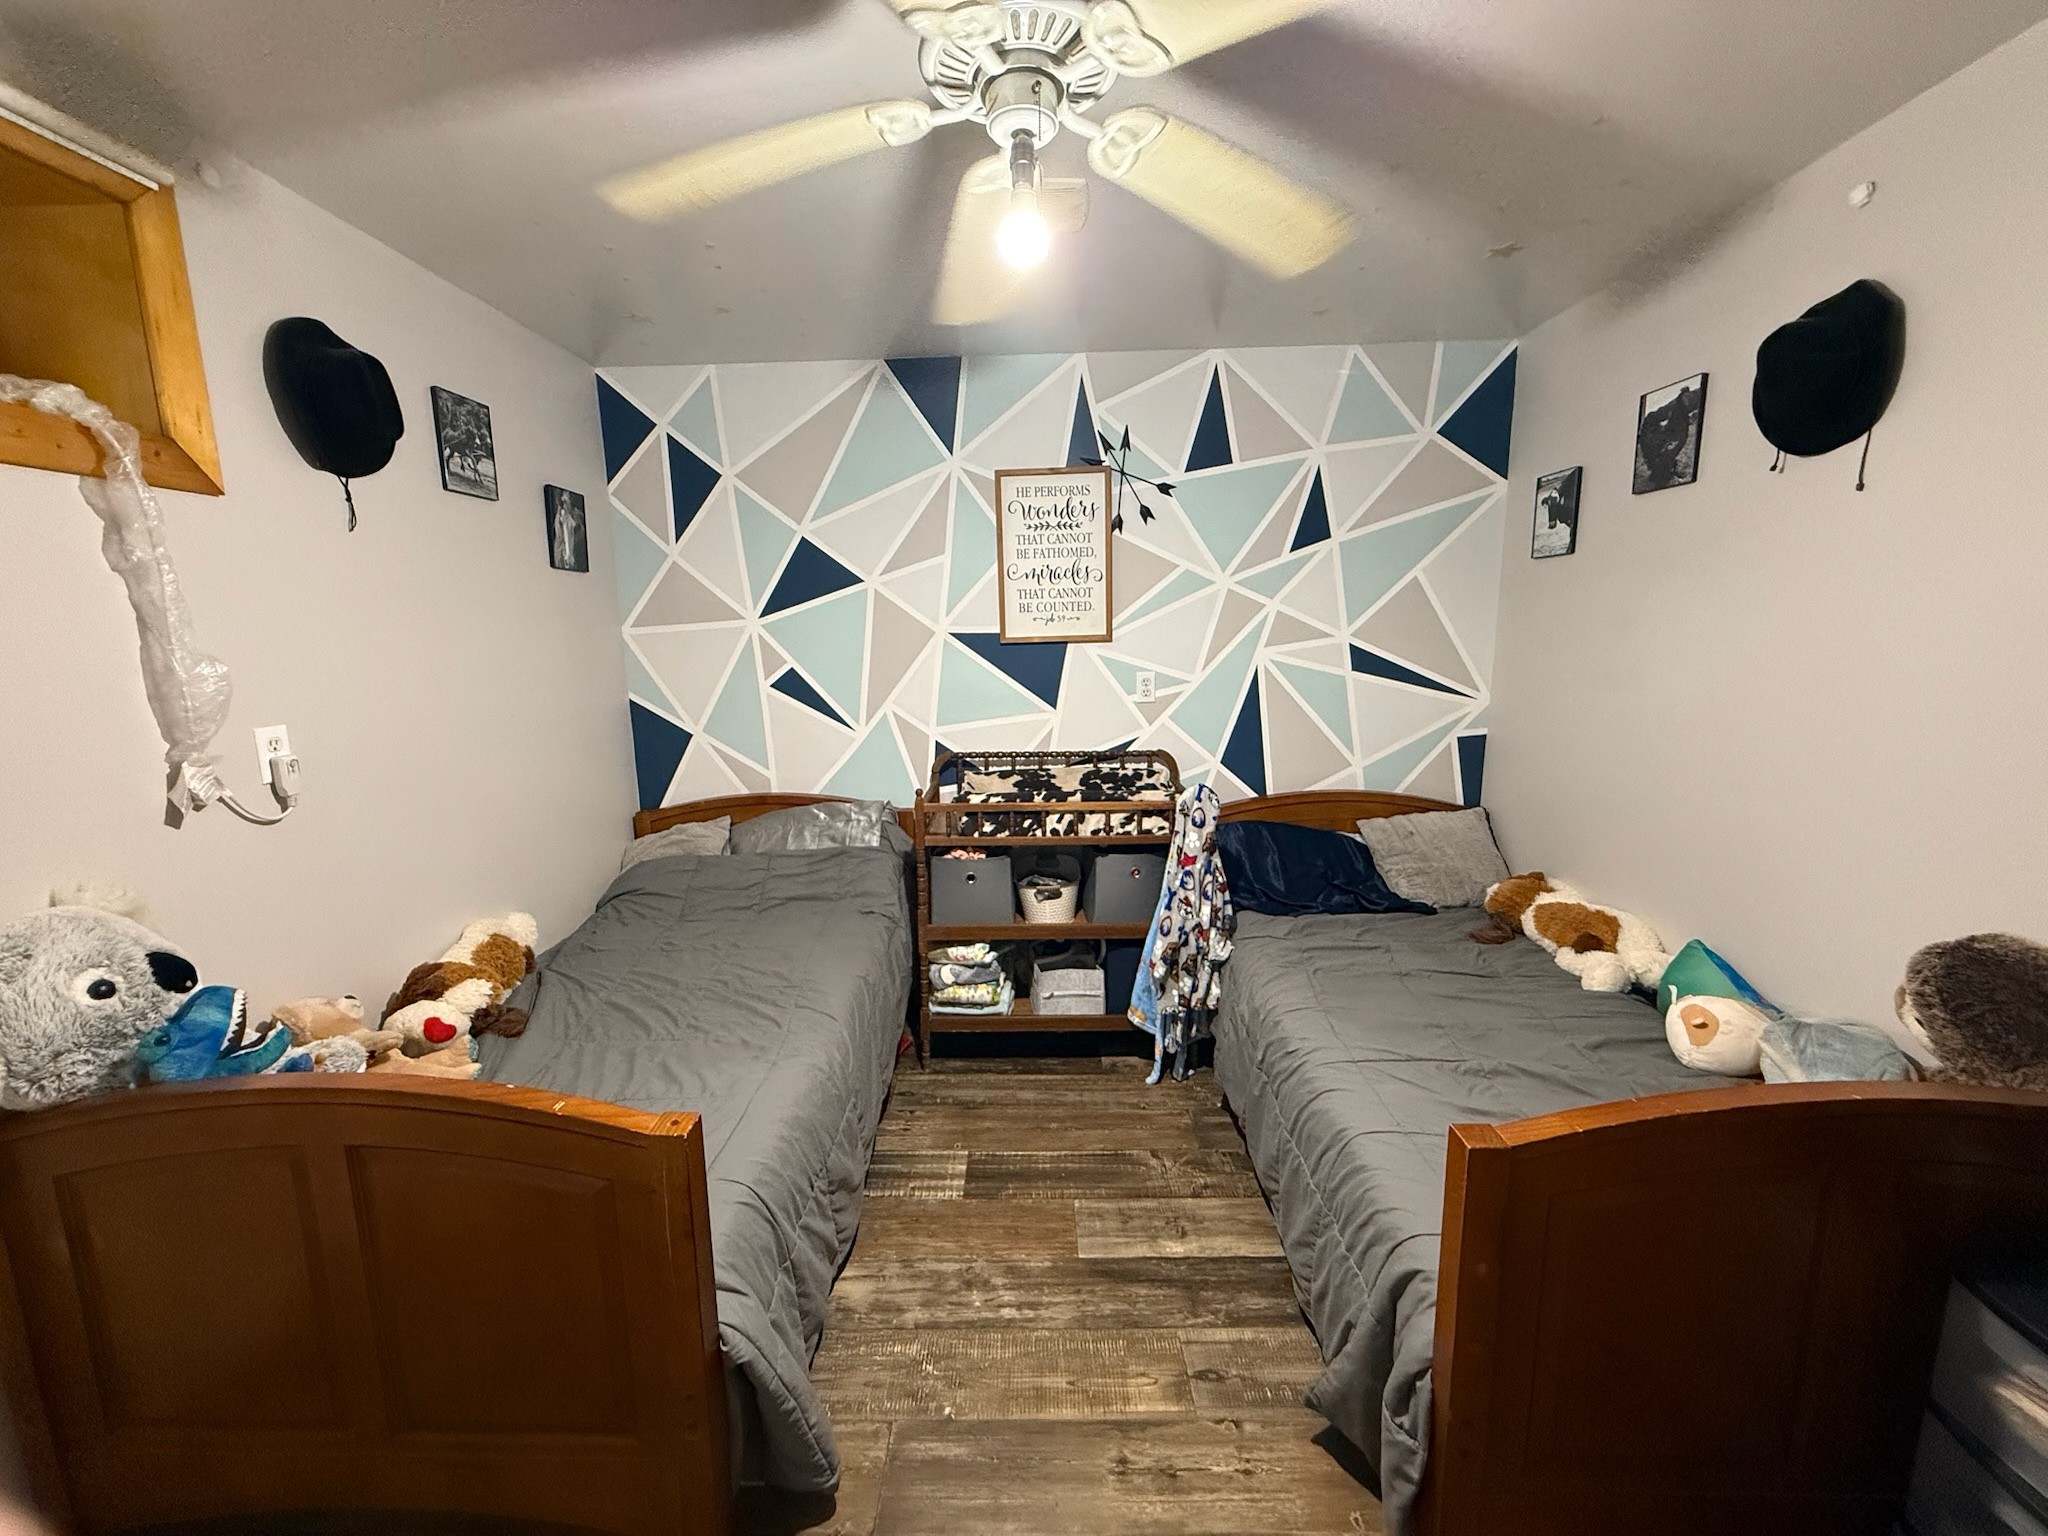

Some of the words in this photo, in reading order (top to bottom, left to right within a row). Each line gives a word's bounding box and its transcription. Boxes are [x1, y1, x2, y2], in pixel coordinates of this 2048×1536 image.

[1016, 486, 1031, 498] HE
[1034, 484, 1091, 497] PERFORMS
[1016, 533, 1044, 545] THAT
[1047, 532, 1093, 544] CANNOT
[1016, 547, 1030, 559] BE
[1033, 546, 1097, 559] FATHOMED,
[1007, 558, 1103, 586] miracles
[1017, 588, 1045, 600] THAT
[1048, 587, 1093, 599] CANNOT
[1019, 602, 1033, 613] BE
[1036, 600, 1095, 613] COUNTED.
